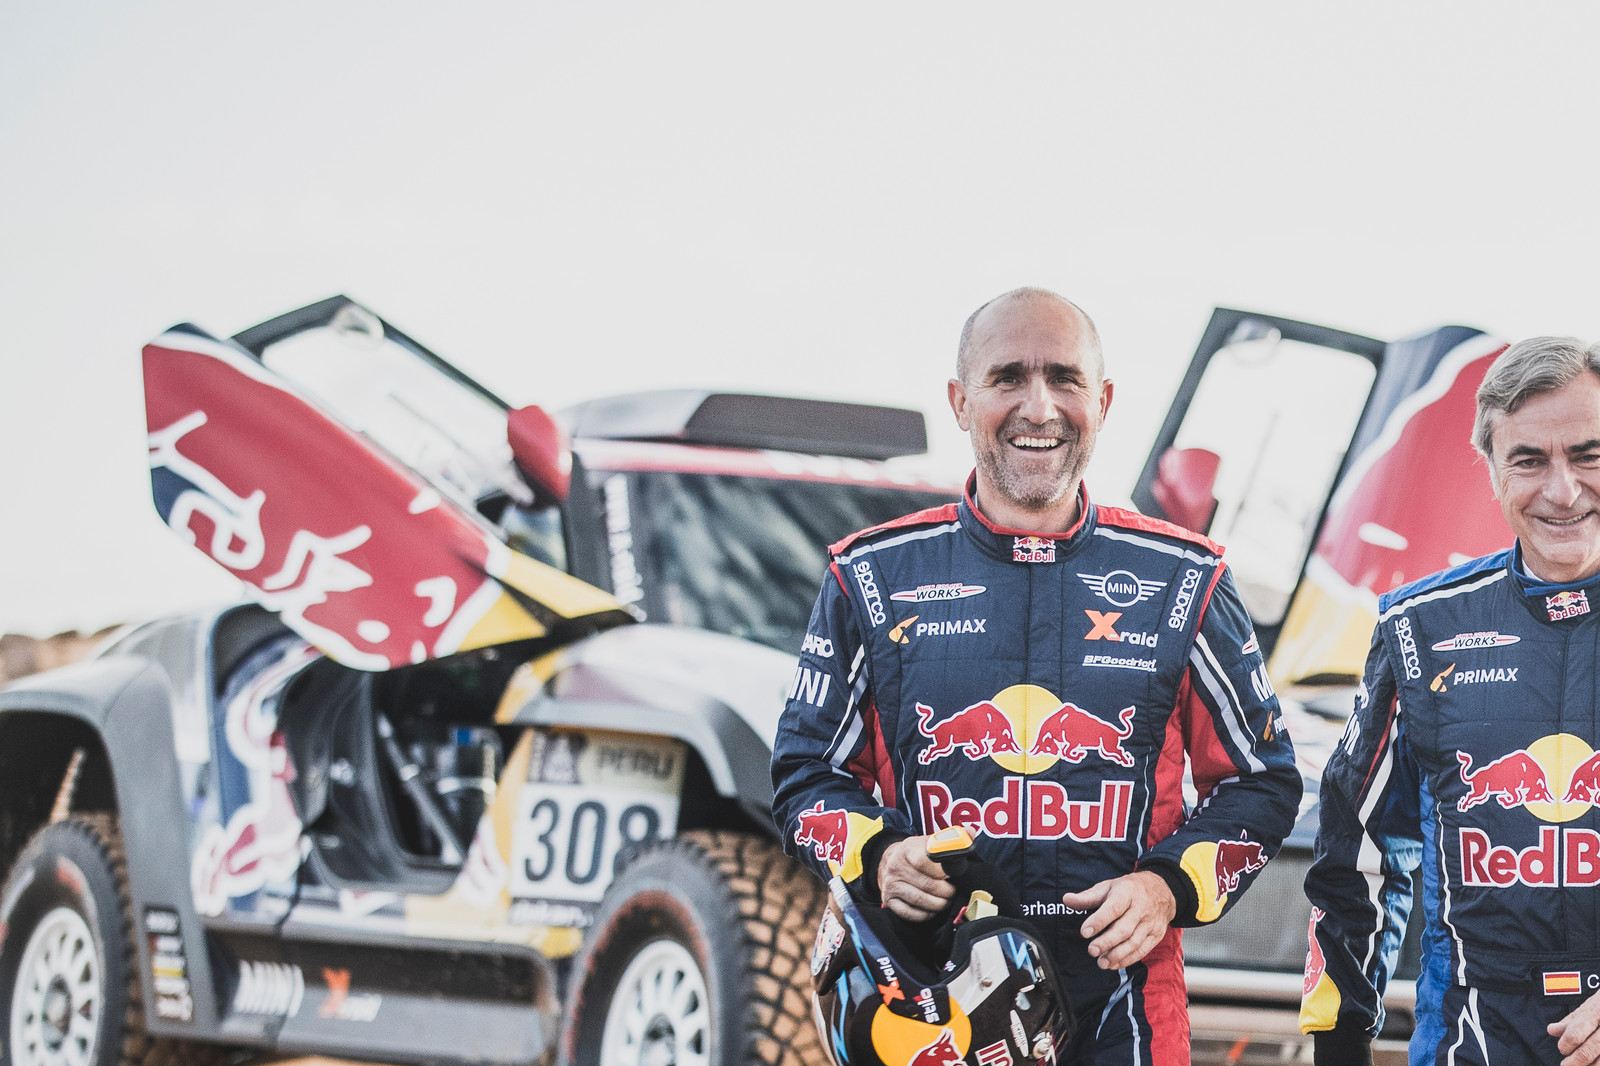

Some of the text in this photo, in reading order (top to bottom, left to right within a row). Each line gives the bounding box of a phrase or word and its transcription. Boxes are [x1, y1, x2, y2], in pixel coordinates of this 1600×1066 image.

[1013, 549, 1055, 562] Red Bull
[854, 561, 886, 627] sparco
[918, 588, 961, 600] WORKS
[1107, 581, 1137, 595] MINI
[1169, 569, 1201, 631] sparco
[1549, 602, 1590, 620] Red Bull
[916, 619, 986, 637] PRIMAX
[1083, 609, 1159, 647] X-raid
[1396, 617, 1422, 679] sparco
[1454, 637, 1497, 648] WORKS
[790, 666, 831, 707] INI
[1453, 668, 1519, 685] PRIMAX
[917, 777, 1135, 841] Red Bull
[525, 799, 660, 885] 308
[1458, 826, 1559, 888] Red
[1020, 901, 1087, 917] erhans
